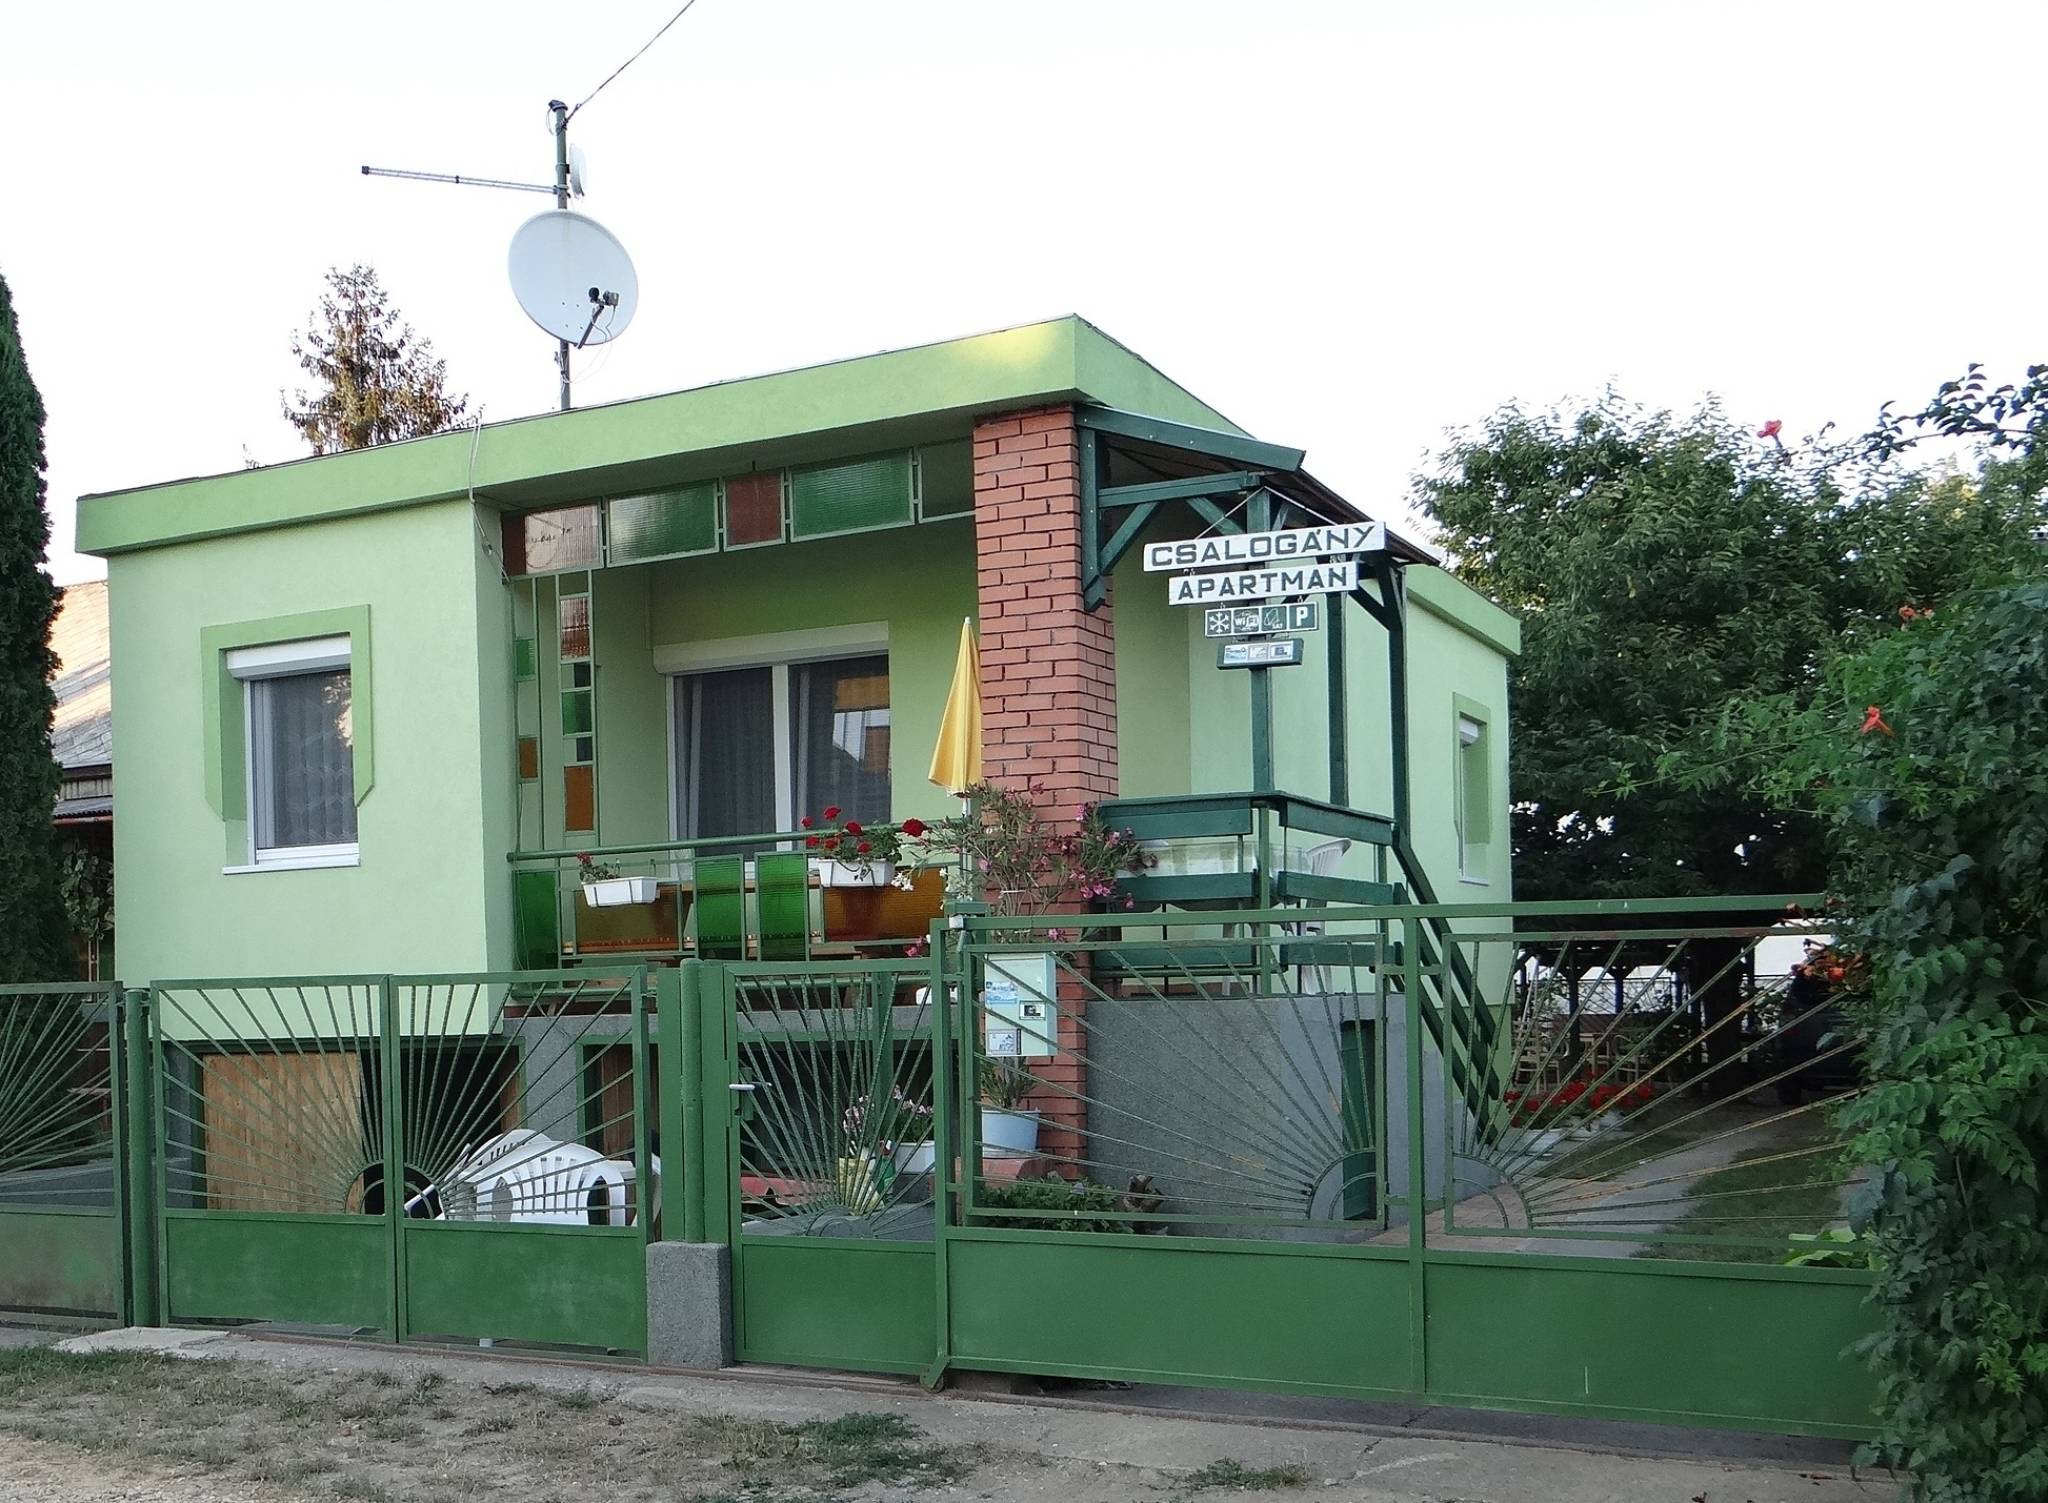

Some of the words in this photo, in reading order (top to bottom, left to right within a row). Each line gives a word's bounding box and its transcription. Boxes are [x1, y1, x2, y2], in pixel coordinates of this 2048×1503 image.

[1151, 525, 1375, 567] CSALOGÁNY
[1178, 566, 1348, 600] APARTMAN
[1296, 606, 1308, 627] P
